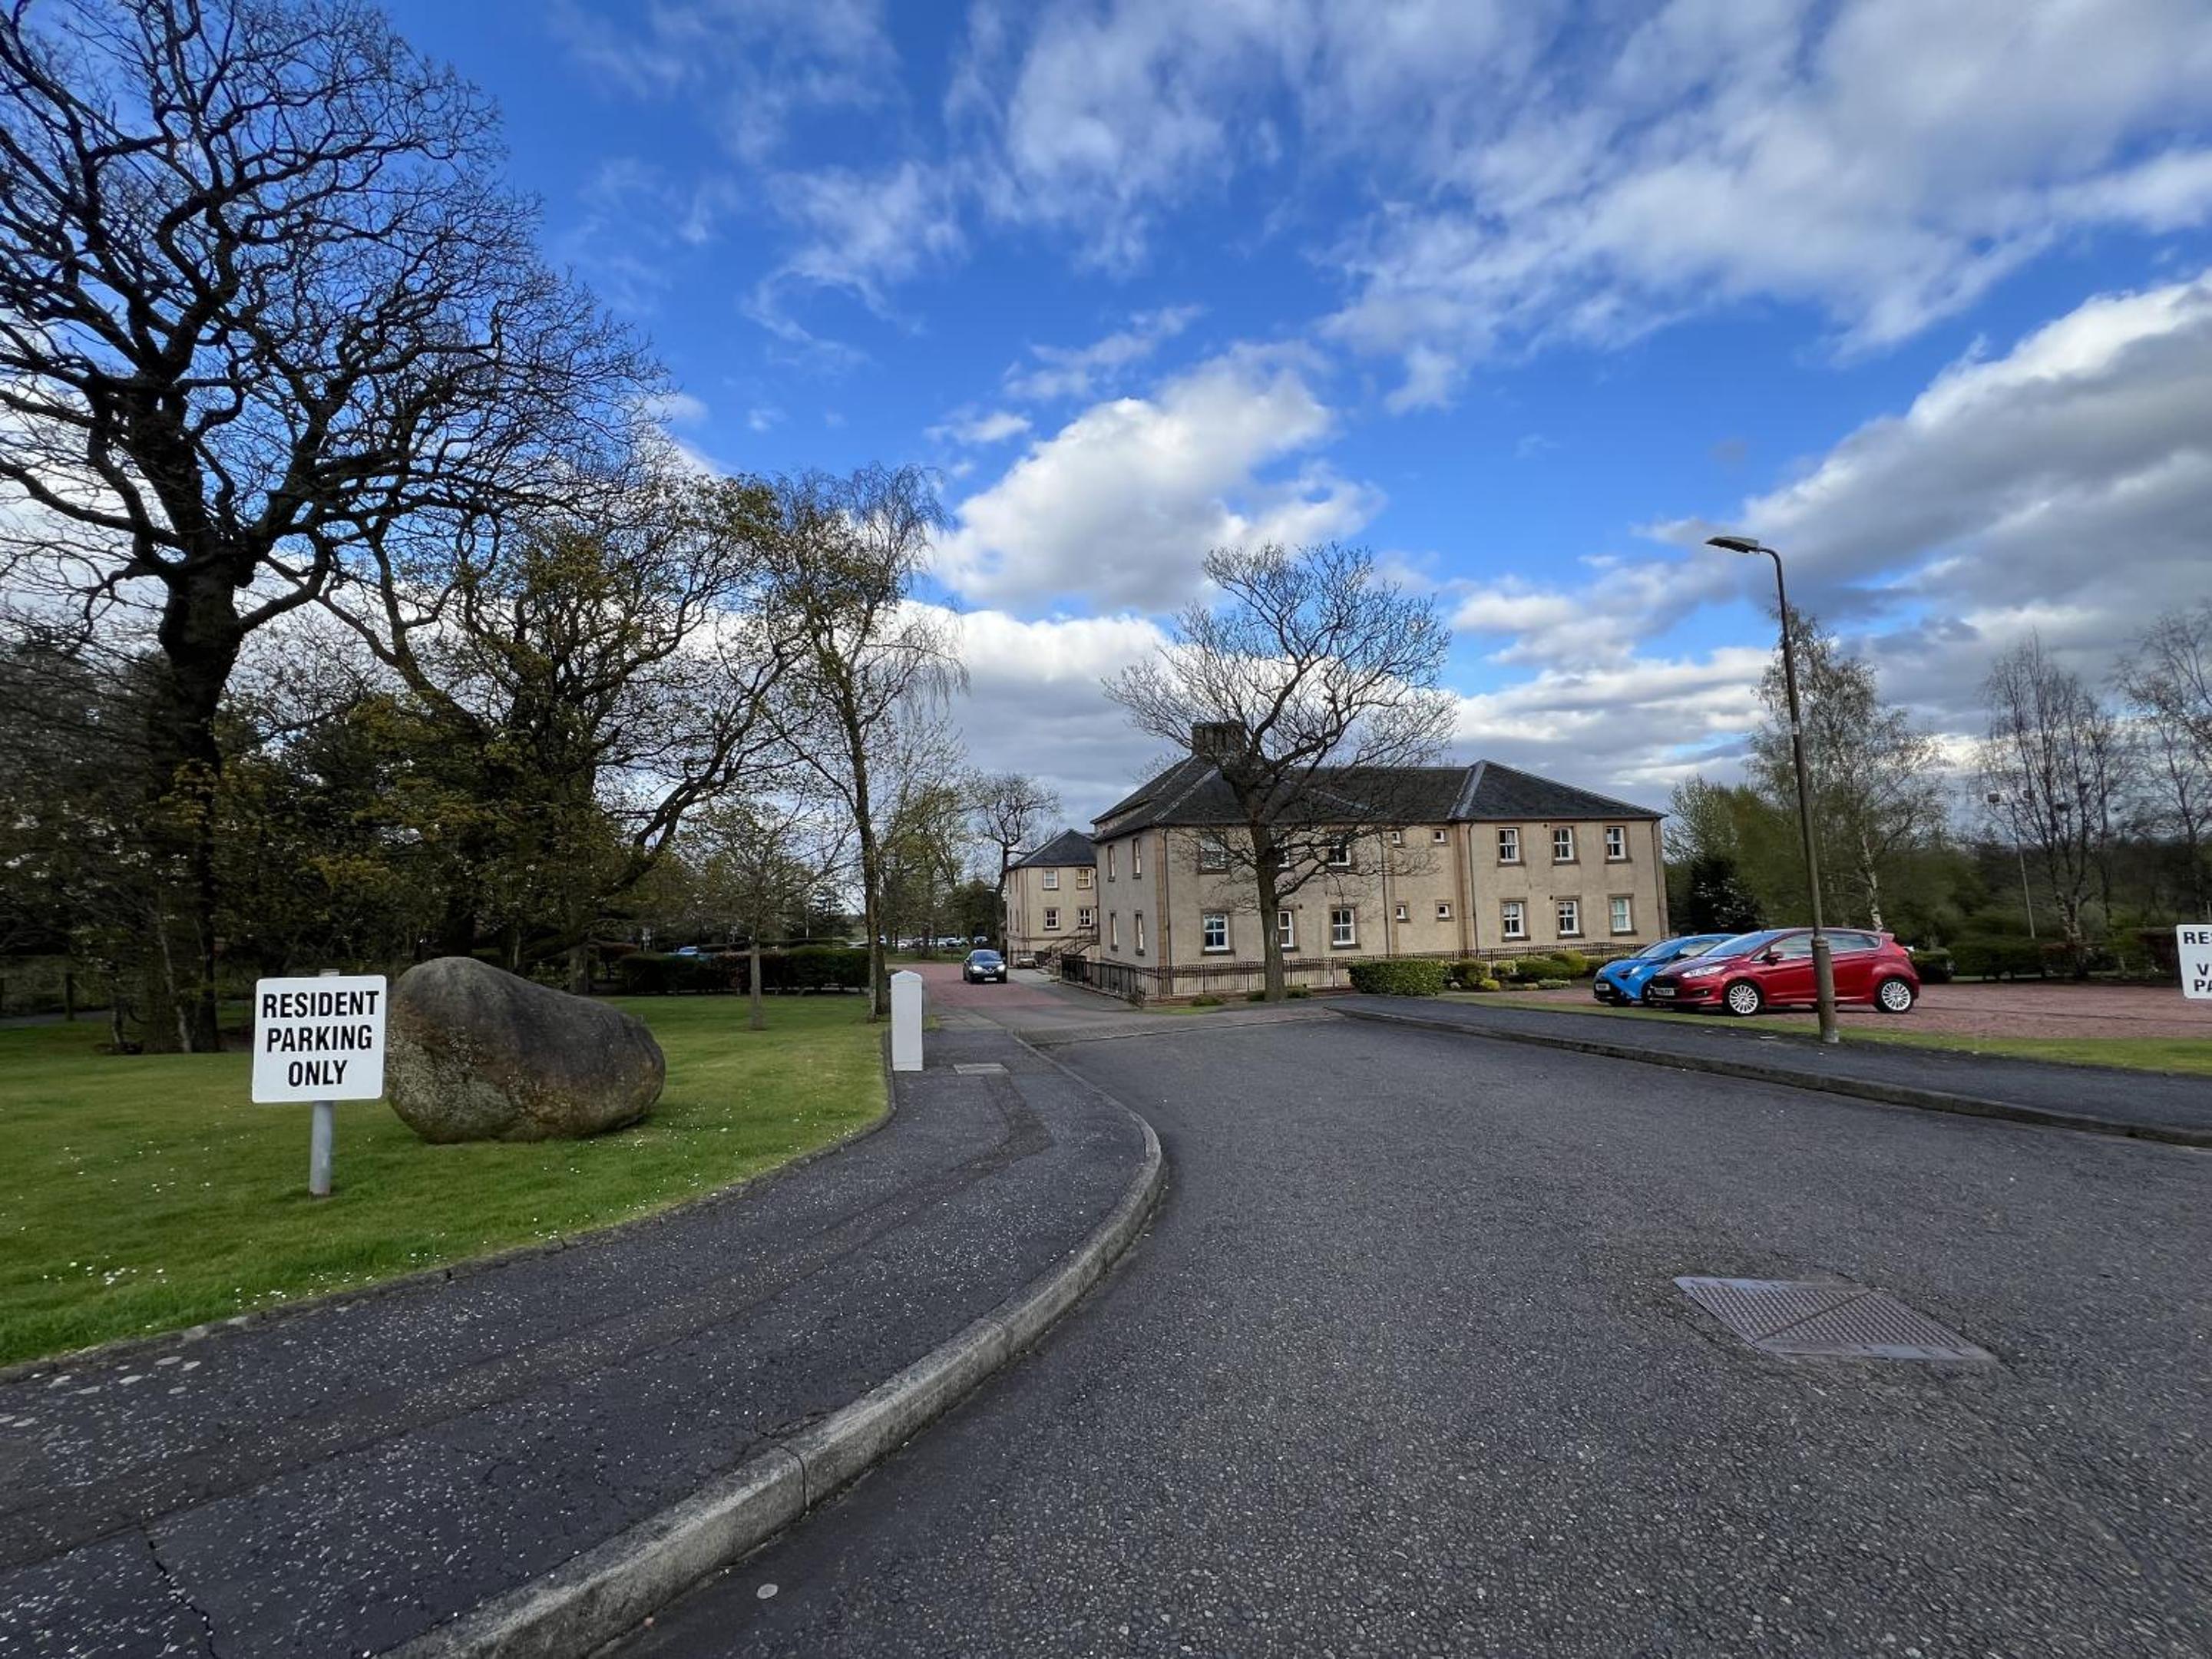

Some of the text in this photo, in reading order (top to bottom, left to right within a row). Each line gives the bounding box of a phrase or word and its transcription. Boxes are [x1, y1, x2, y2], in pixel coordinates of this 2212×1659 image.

[2184, 931, 2212, 944] RE
[262, 990, 379, 1018] RESIDENT
[266, 1025, 372, 1053] PARKING
[288, 1060, 348, 1087] ONLY
